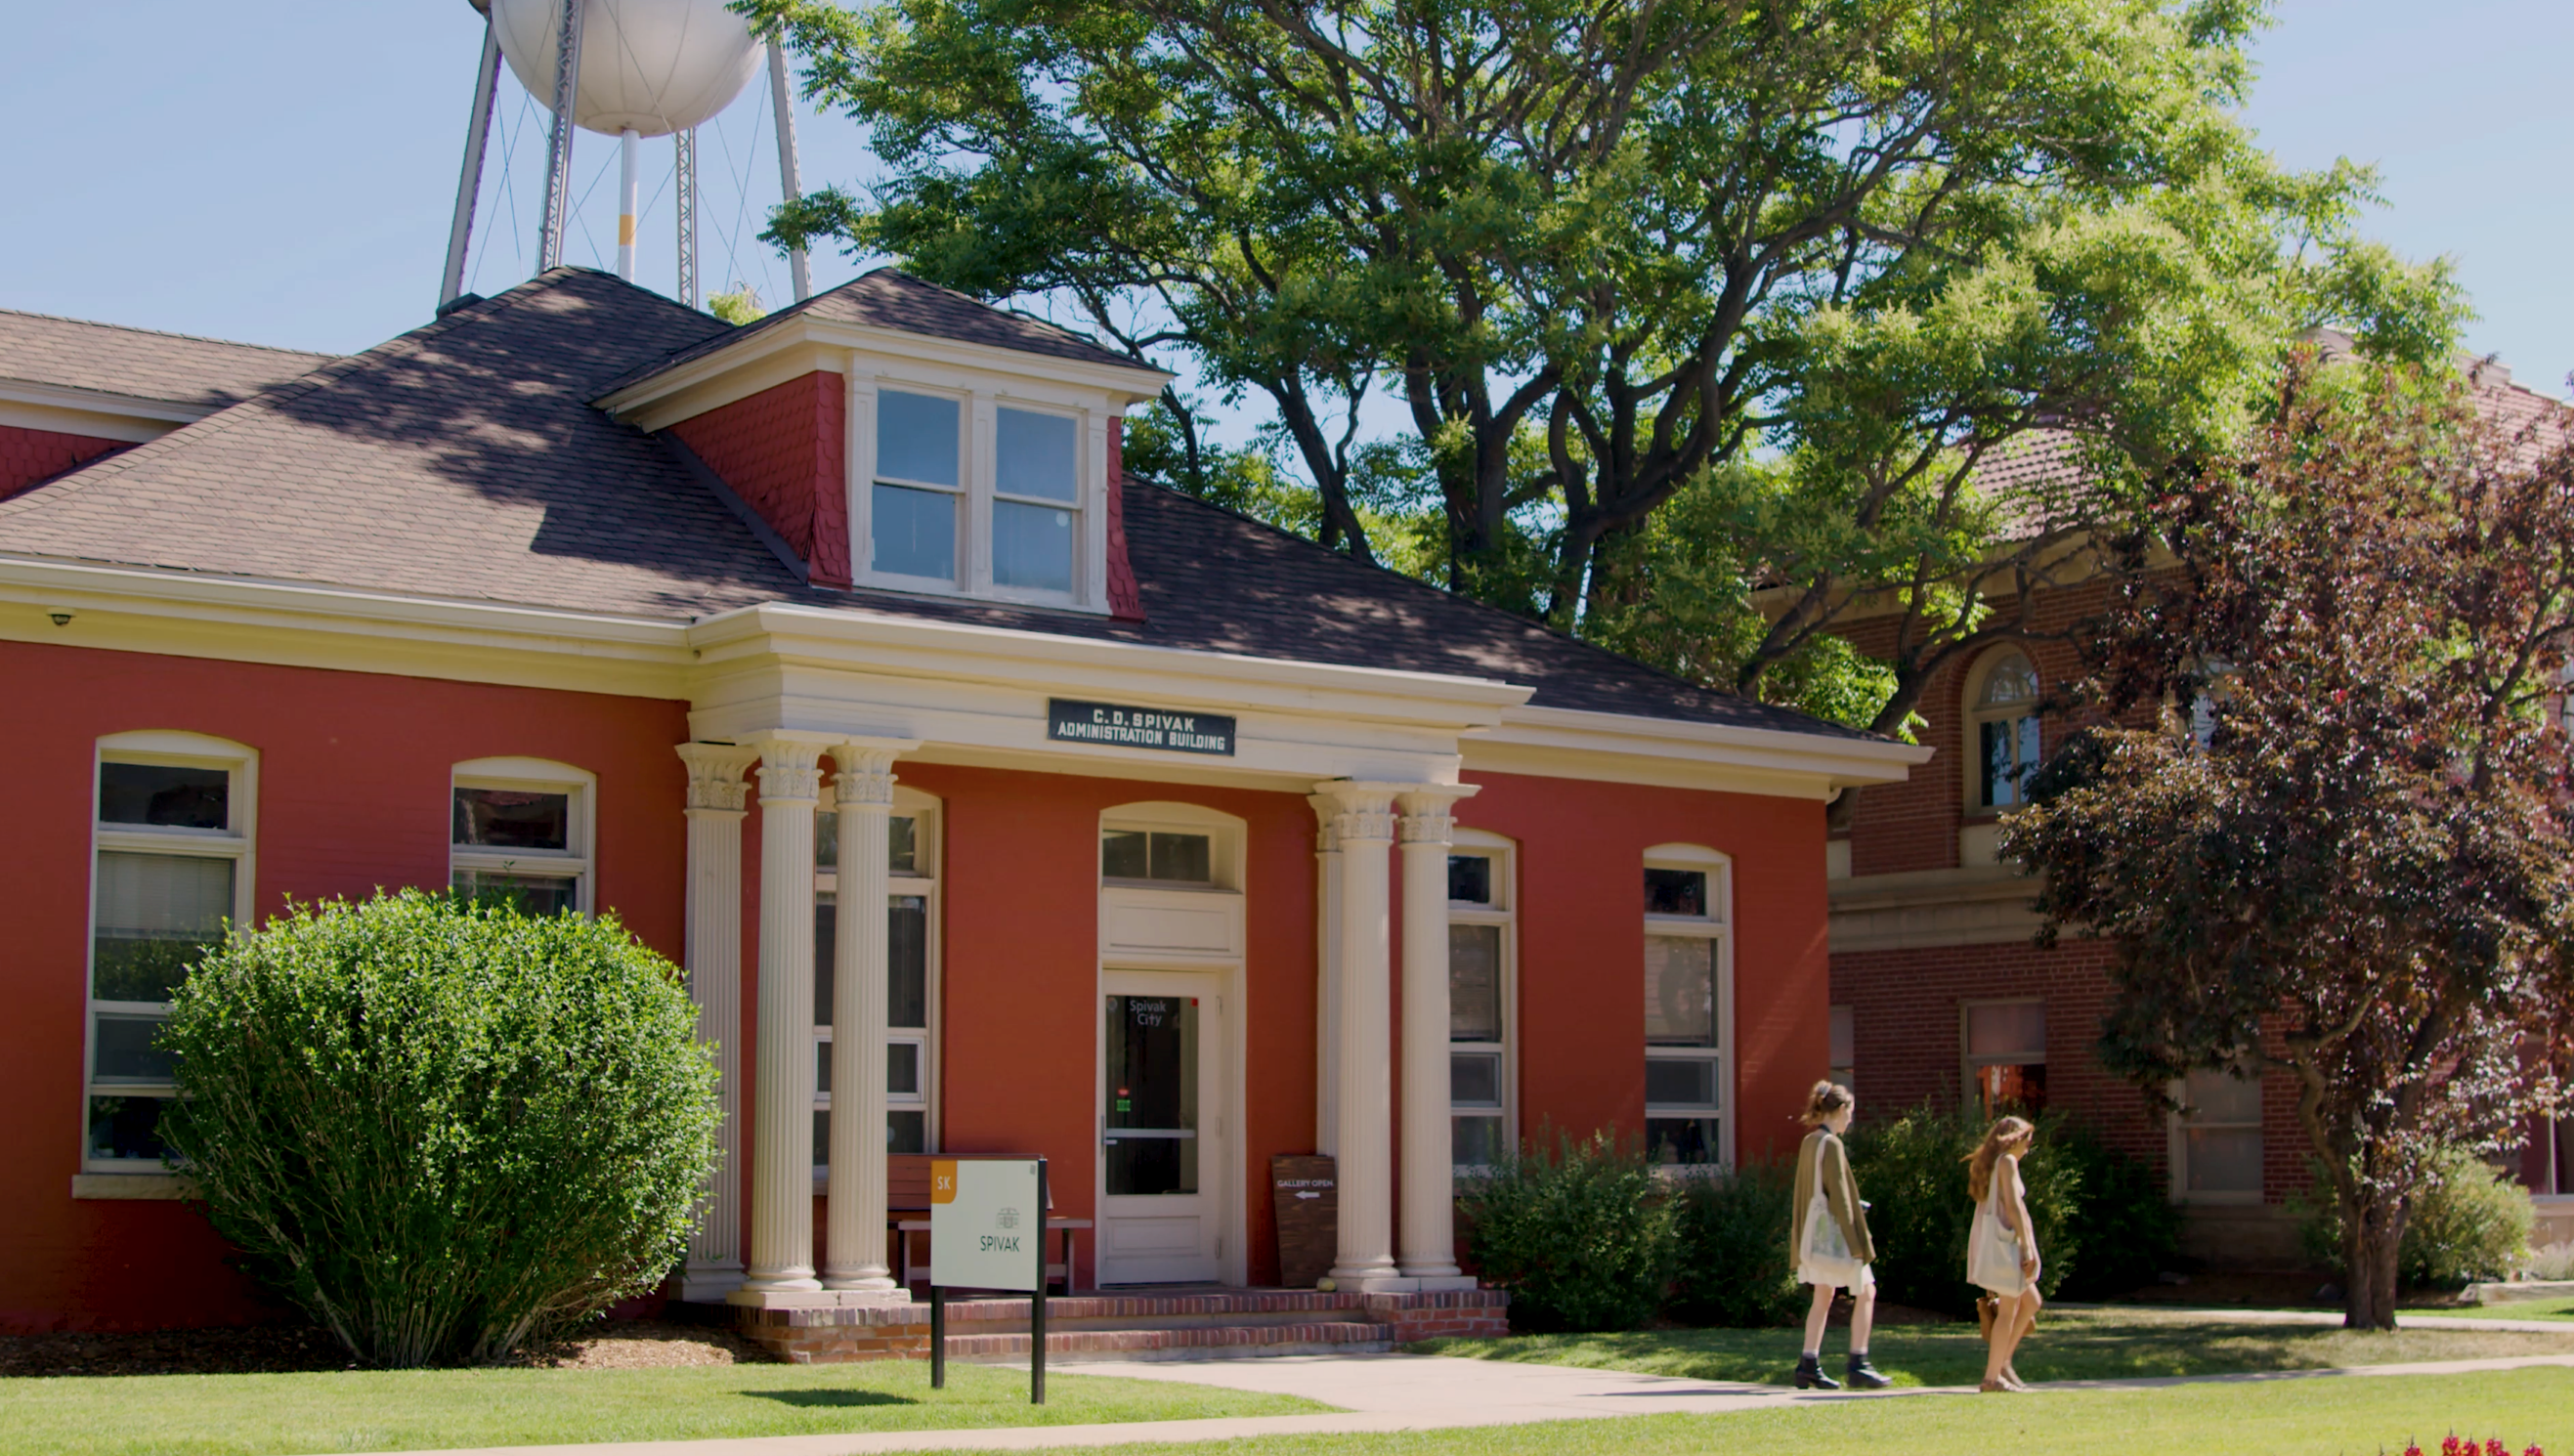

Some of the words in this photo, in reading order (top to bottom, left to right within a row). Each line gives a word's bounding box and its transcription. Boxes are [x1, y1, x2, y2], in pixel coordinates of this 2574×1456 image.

[1057, 721, 1163, 745] ADMINISTRATION
[1169, 731, 1225, 750] BUILDING
[1130, 1000, 1167, 1013] Spivak
[1137, 1013, 1162, 1026] City
[937, 1176, 951, 1190] SK
[980, 1235, 1020, 1252] SPIVAK
